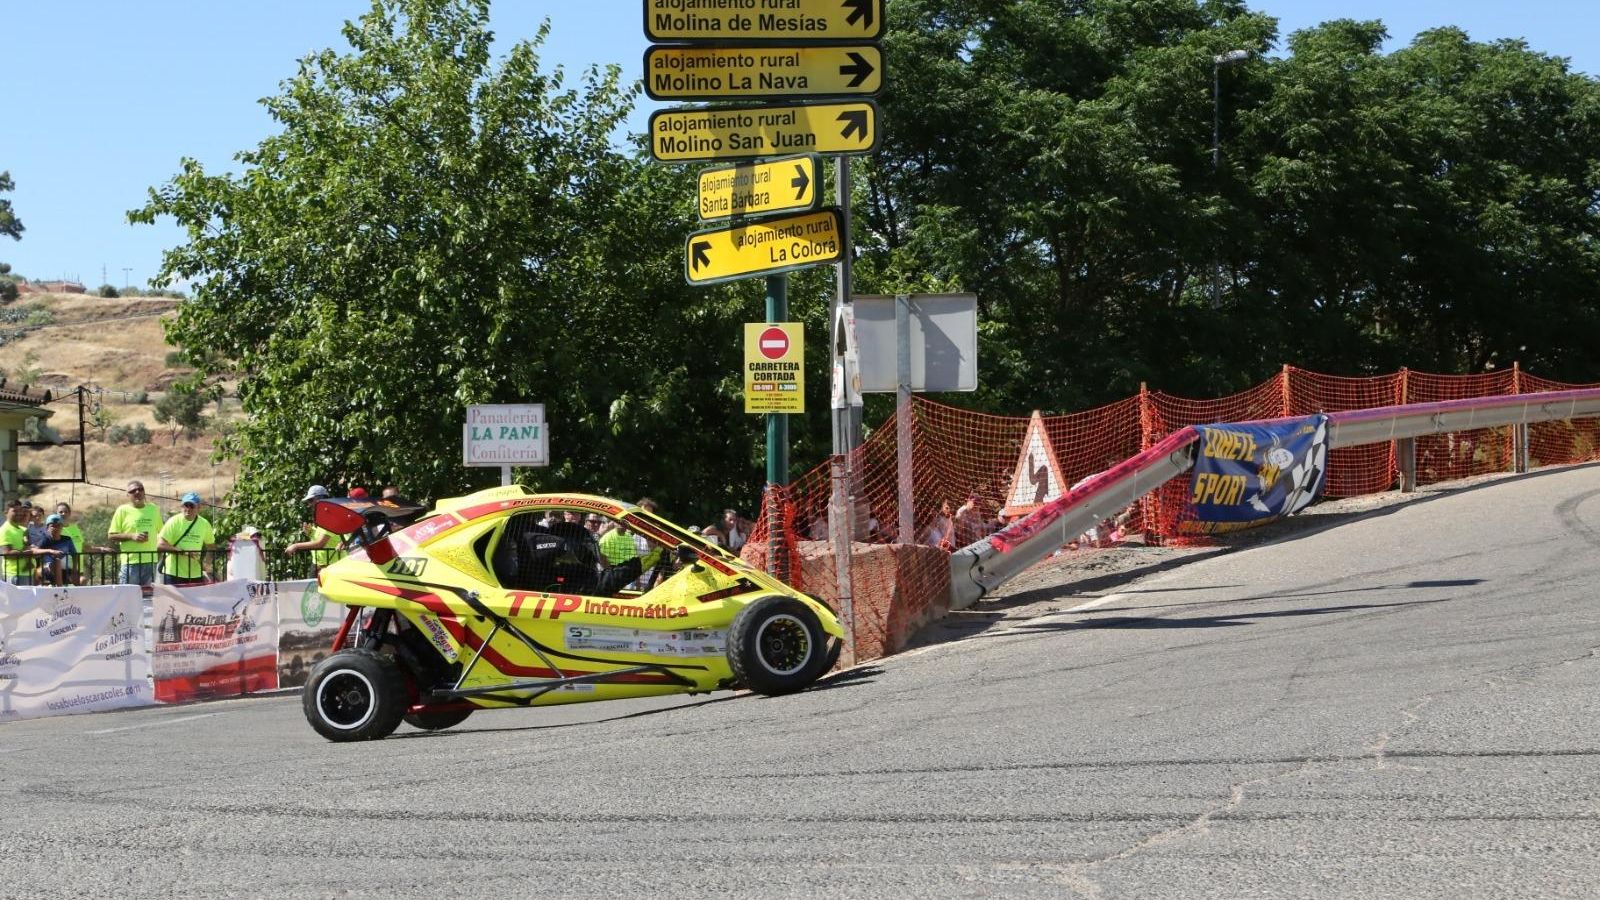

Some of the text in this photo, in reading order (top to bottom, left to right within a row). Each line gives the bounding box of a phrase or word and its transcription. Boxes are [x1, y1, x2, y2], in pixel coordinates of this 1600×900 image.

[655, 0, 800, 11] alojamiento rural
[655, 14, 828, 31] Molina de Mesías
[655, 52, 800, 72] alojamiento rural
[655, 73, 808, 91] Molino La Nava
[659, 111, 796, 136] alojamiento rural
[660, 131, 816, 154] Molino San Juan
[702, 168, 771, 194] alojamiento rural
[702, 196, 728, 214] Santa
[738, 217, 833, 247] alojamiento rural
[770, 236, 836, 263] La Colorá
[748, 362, 800, 371] CARRETERA
[753, 372, 795, 381] CORTADA
[471, 427, 493, 441] LA
[1191, 473, 1248, 506] SPORT
